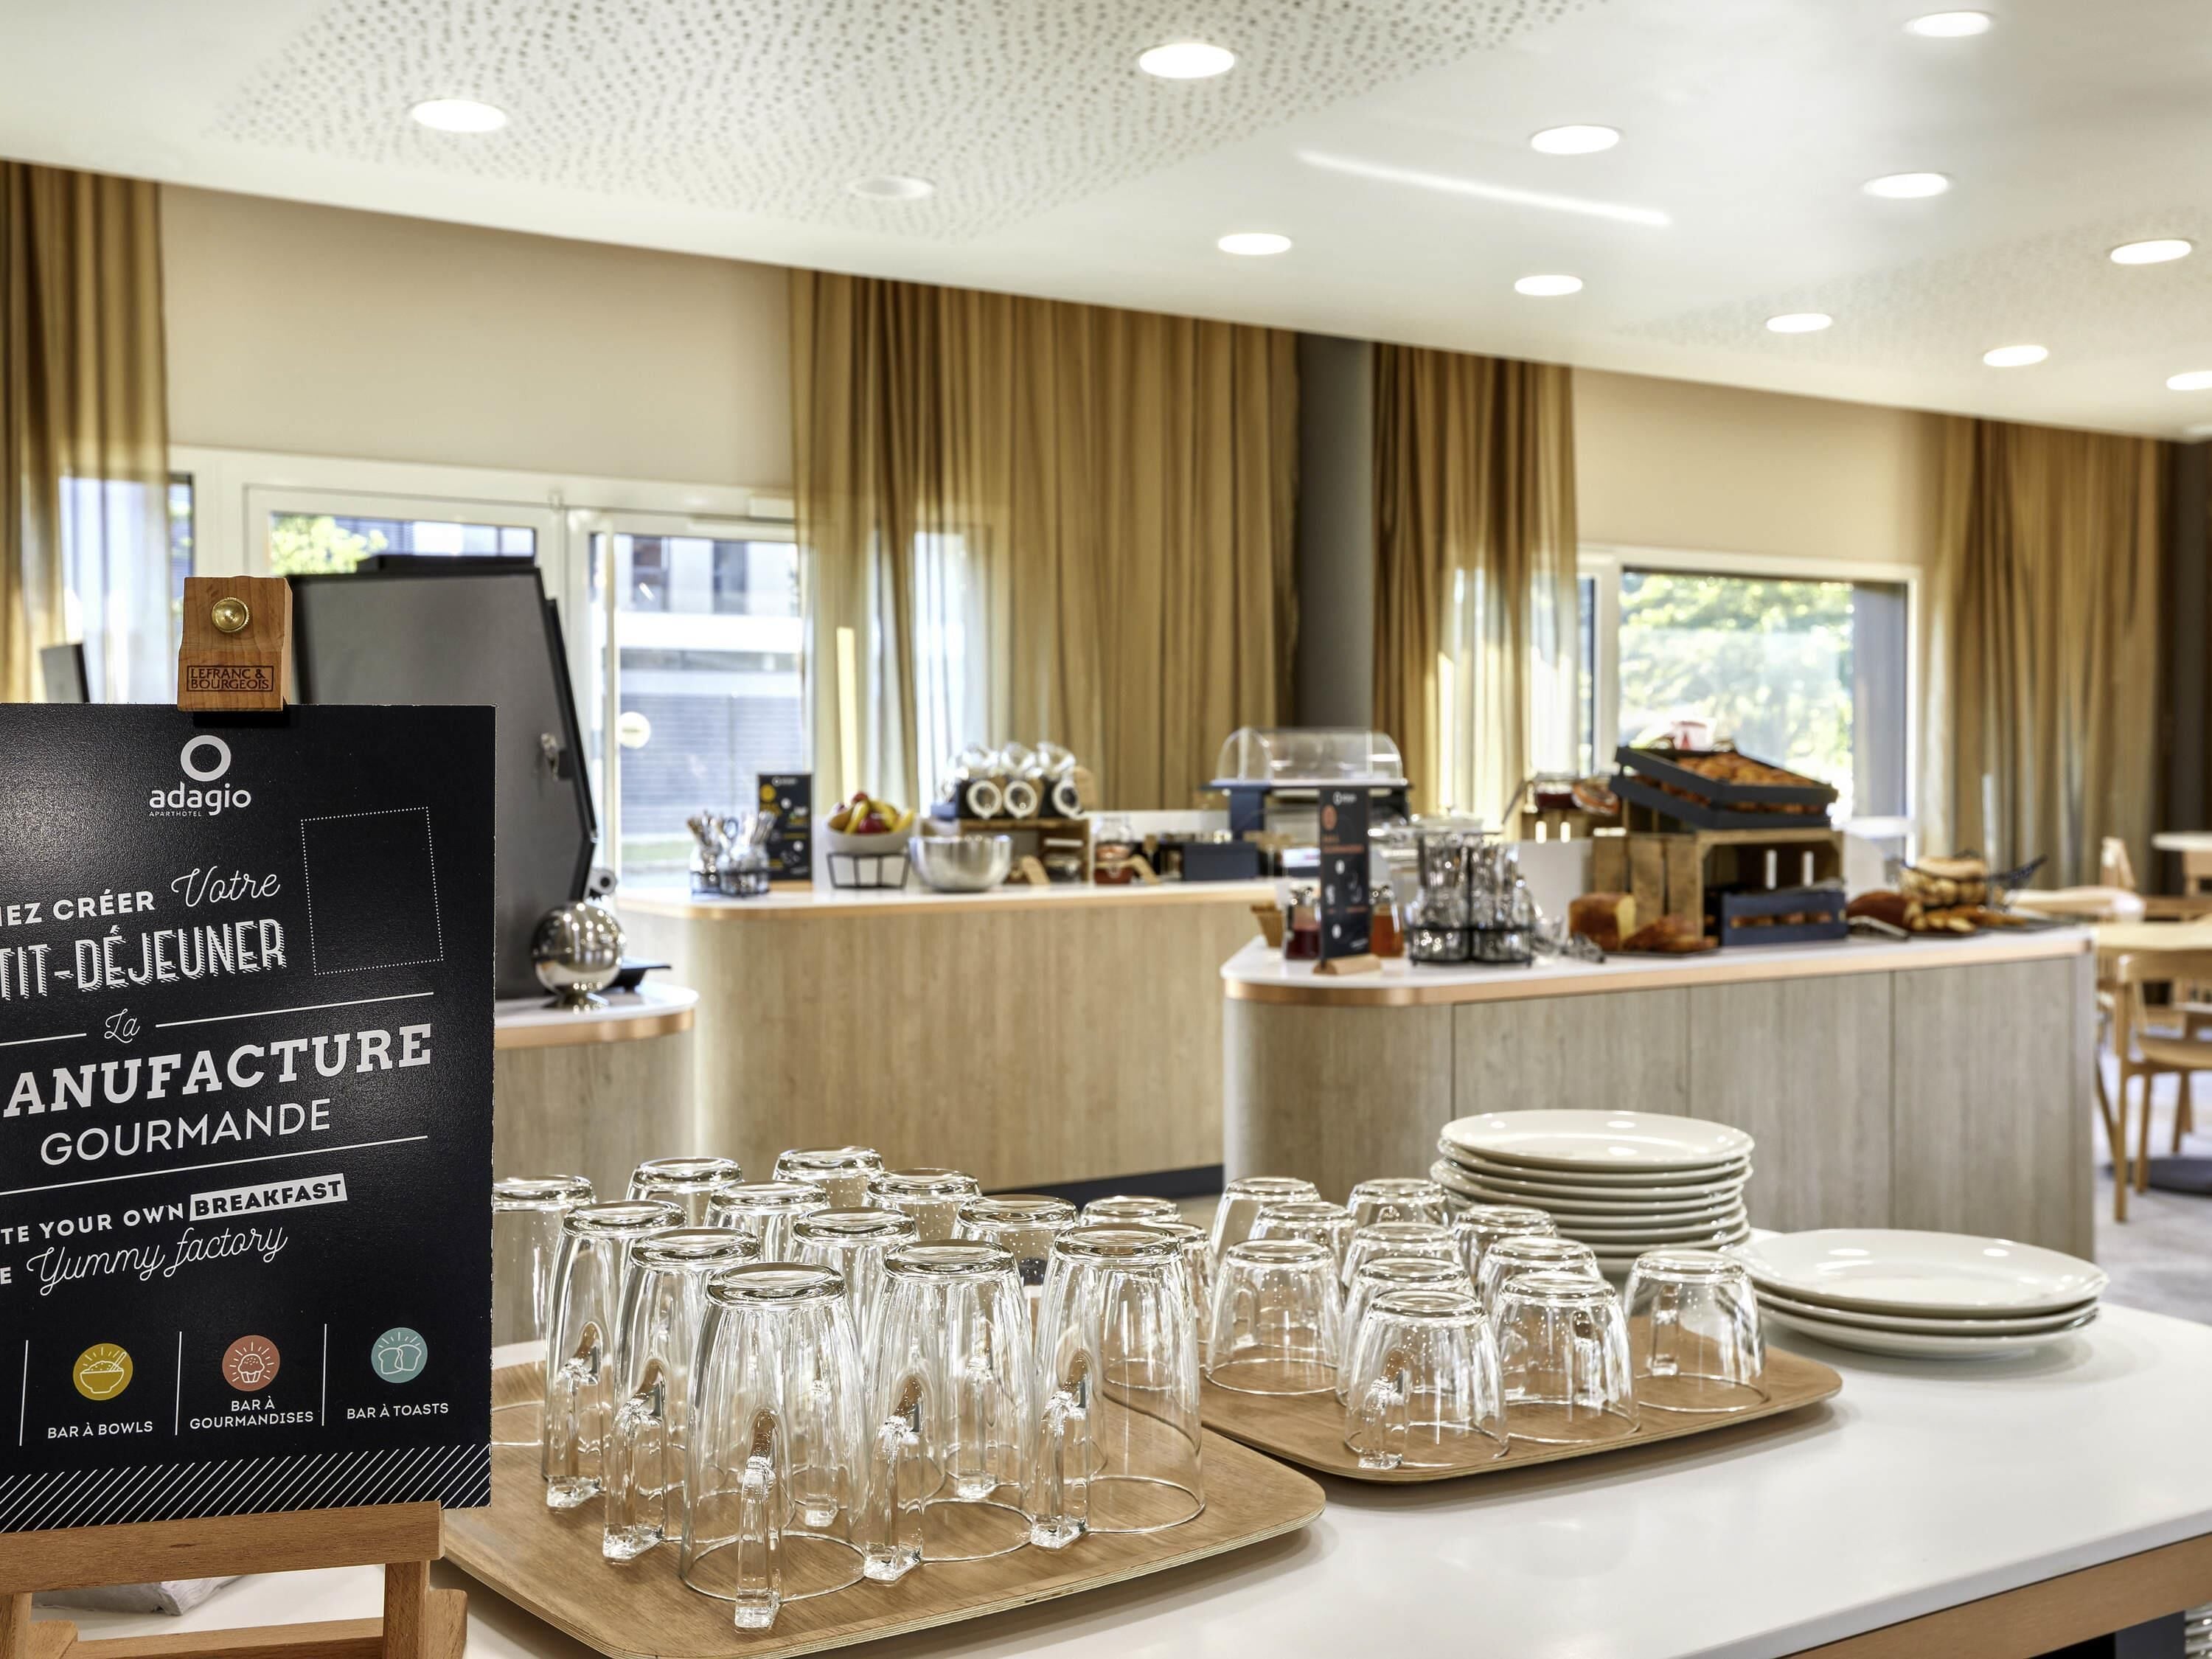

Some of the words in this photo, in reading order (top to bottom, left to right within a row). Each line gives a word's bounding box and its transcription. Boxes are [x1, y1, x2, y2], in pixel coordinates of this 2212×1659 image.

[190, 667, 251, 680] LEFRANC
[254, 668, 266, 680] &
[191, 678, 269, 689] BOURGEOIS
[149, 781, 251, 816] adagio
[0, 902, 43, 927] EZ
[52, 888, 156, 921] CRÉER
[170, 866, 281, 908] Votre
[104, 1008, 141, 1043] La
[40, 1098, 331, 1165] GOURMANDE
[38, 1214, 113, 1239] YOUR
[123, 1203, 184, 1227] OWN
[195, 1180, 341, 1217] BREAKFAST
[26, 1245, 165, 1296] Yummy
[161, 1227, 288, 1278] factory
[231, 1399, 260, 1412] BAR
[263, 1395, 276, 1410] À
[347, 1407, 376, 1419] BAR
[379, 1403, 391, 1418] À
[393, 1402, 449, 1416] TOASTS
[48, 1426, 79, 1439] BAR
[83, 1422, 94, 1437] À
[98, 1421, 153, 1436] BOWLS
[189, 1411, 313, 1430] GOURMANDISES
